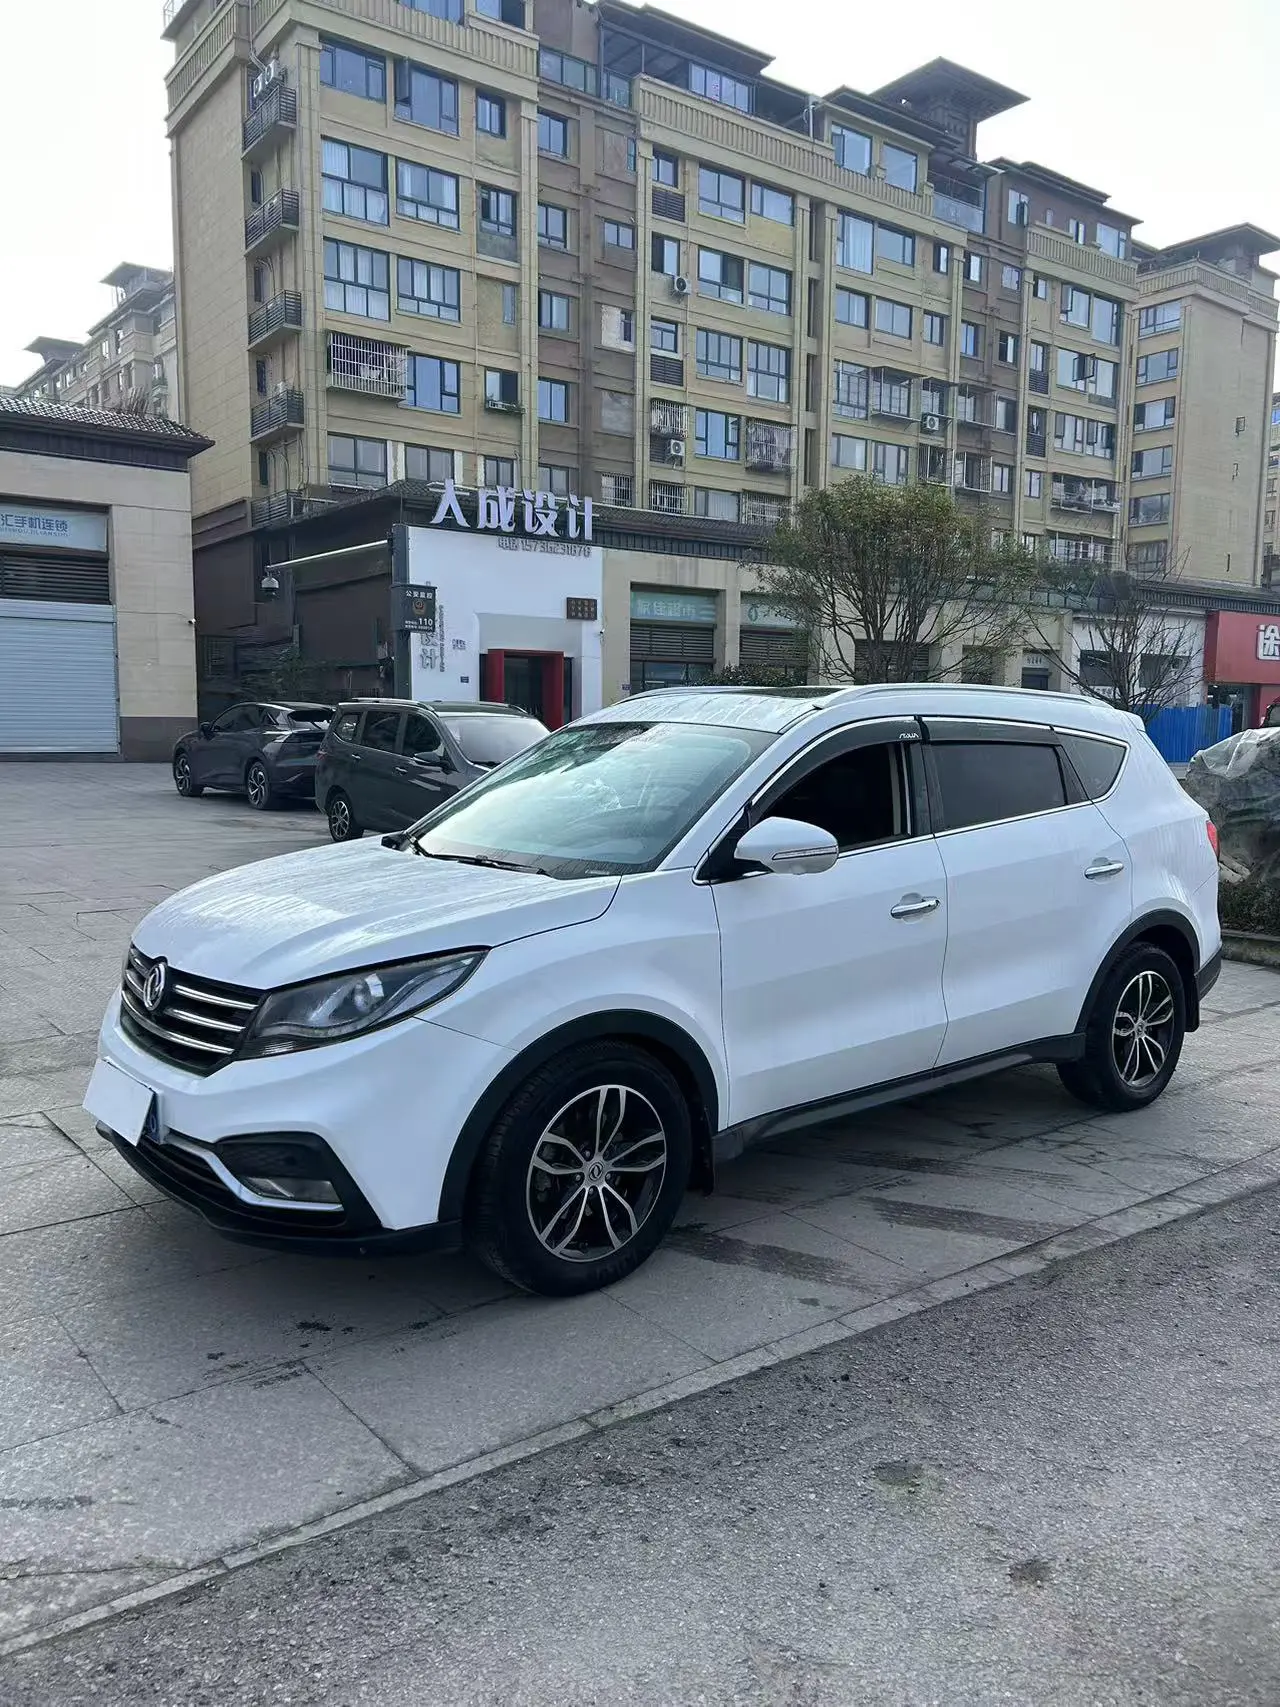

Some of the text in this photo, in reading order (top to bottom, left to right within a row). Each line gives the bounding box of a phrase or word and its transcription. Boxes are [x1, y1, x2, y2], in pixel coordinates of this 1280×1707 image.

[0, 513, 68, 533] 汇手机连锁
[419, 617, 434, 626] 110
